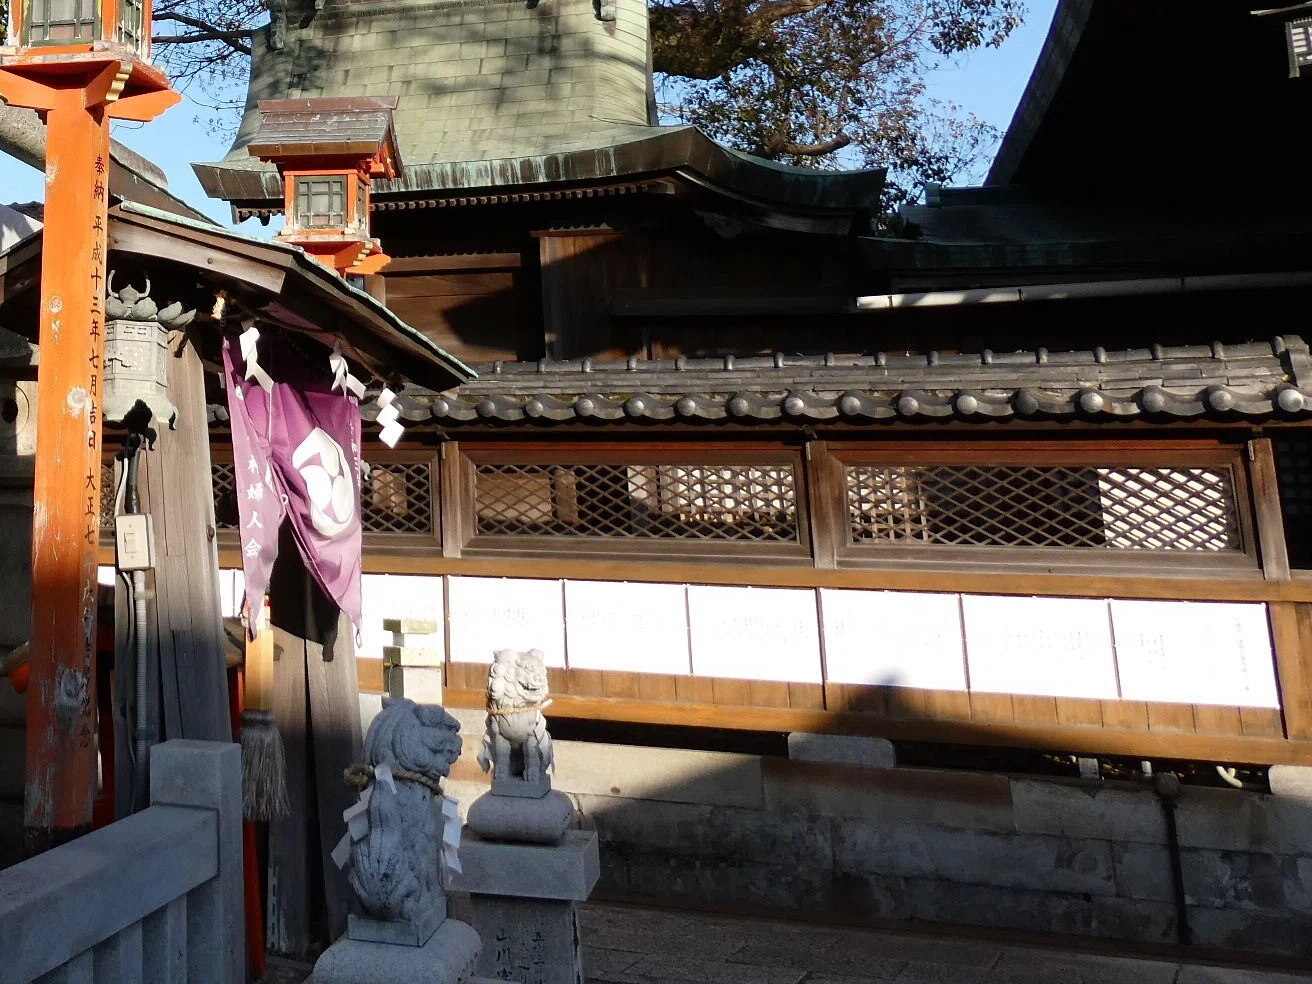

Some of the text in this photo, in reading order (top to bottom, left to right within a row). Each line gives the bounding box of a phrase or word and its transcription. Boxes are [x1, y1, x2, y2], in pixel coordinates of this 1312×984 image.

[93, 153, 105, 203] 奉納
[88, 215, 104, 450] 平成十三年七月吉日
